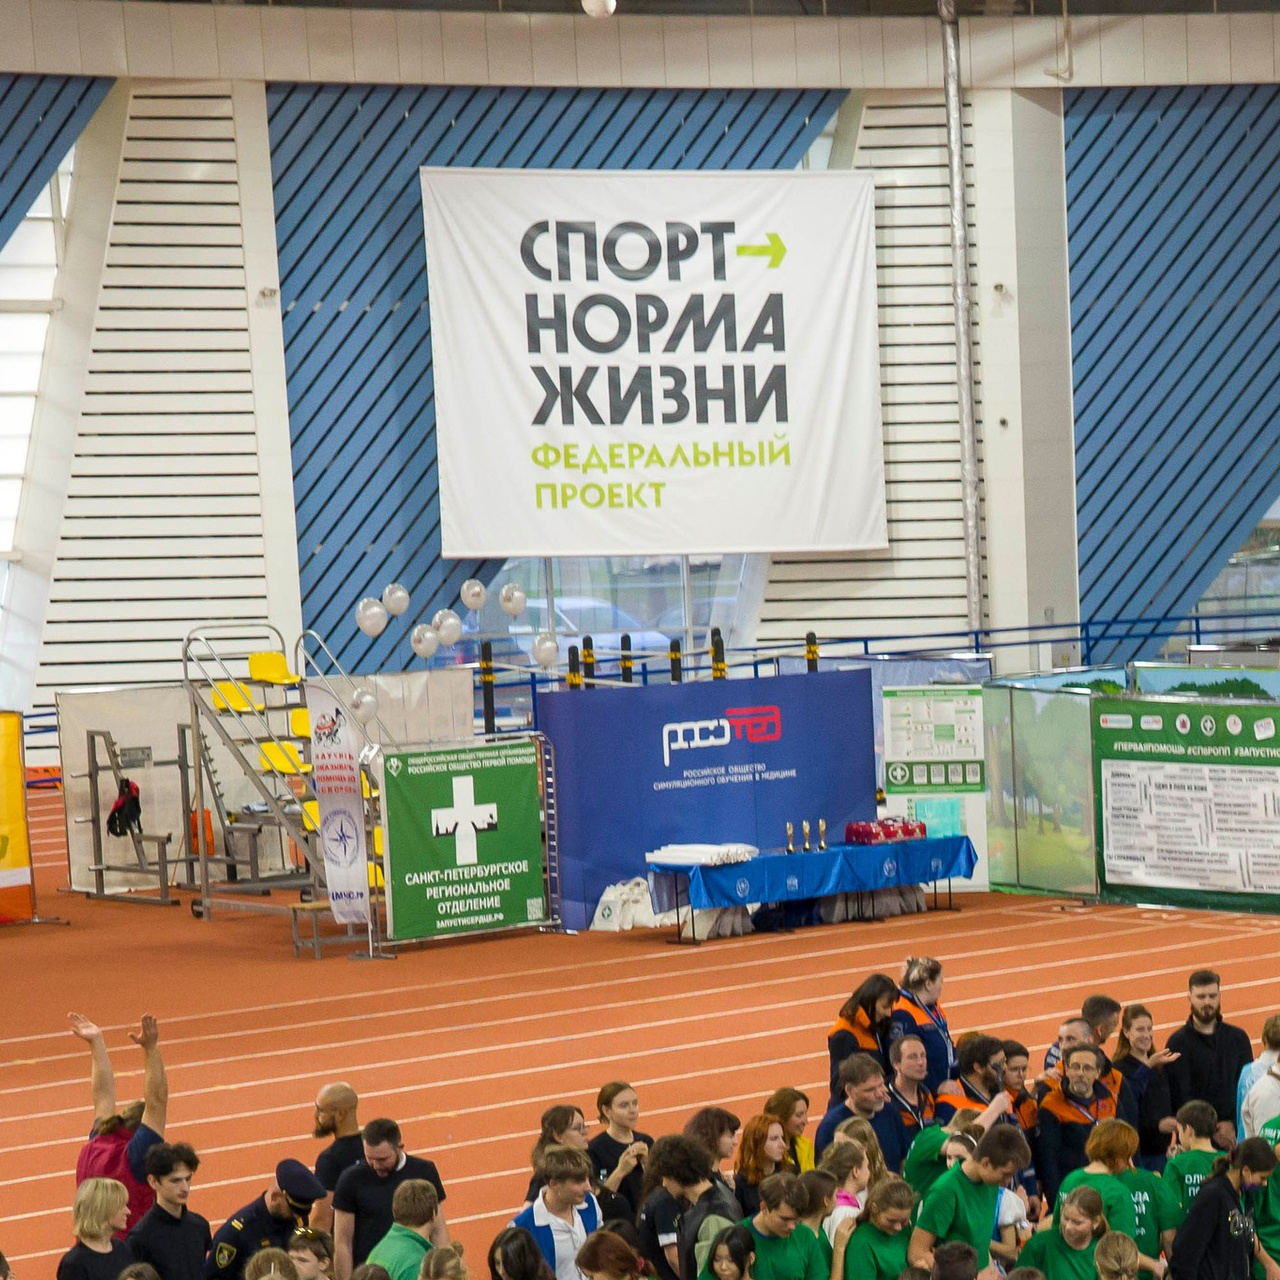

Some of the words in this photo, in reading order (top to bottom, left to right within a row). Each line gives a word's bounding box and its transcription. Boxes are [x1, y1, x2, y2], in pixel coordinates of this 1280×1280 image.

[520, 220, 736, 282] СПОРТ
[525, 292, 786, 354] НОРМА
[531, 364, 789, 426] ЖИЗНИ
[531, 434, 791, 475] ФЕДЕРАЛЬНЫЙ
[535, 482, 666, 510] ПРОЕКТ
[408, 762, 447, 774] РОССИЙСКОЕ
[448, 760, 481, 771] ОБЩЕСТВО
[482, 757, 506, 768] ПЕРВОЙ
[507, 755, 536, 765] ПОМОЩИ
[683, 766, 725, 778] РОССИЙСКОЕ
[728, 763, 766, 774] ОБЩЕСТВО
[653, 778, 715, 791] СИМУЛЯЦИОННОГО
[717, 774, 753, 785] ОБУЧЕНИЯ
[755, 773, 759, 781] В
[761, 769, 797, 780] МЕДИЦИНЕ
[405, 860, 529, 885] САНКТ-ПЕТЕРБУРГСКОЕ
[426, 878, 511, 899] РЕГИОНАЛЬНОЕ
[437, 895, 500, 915] ОТДЕЛЕНИЕ
